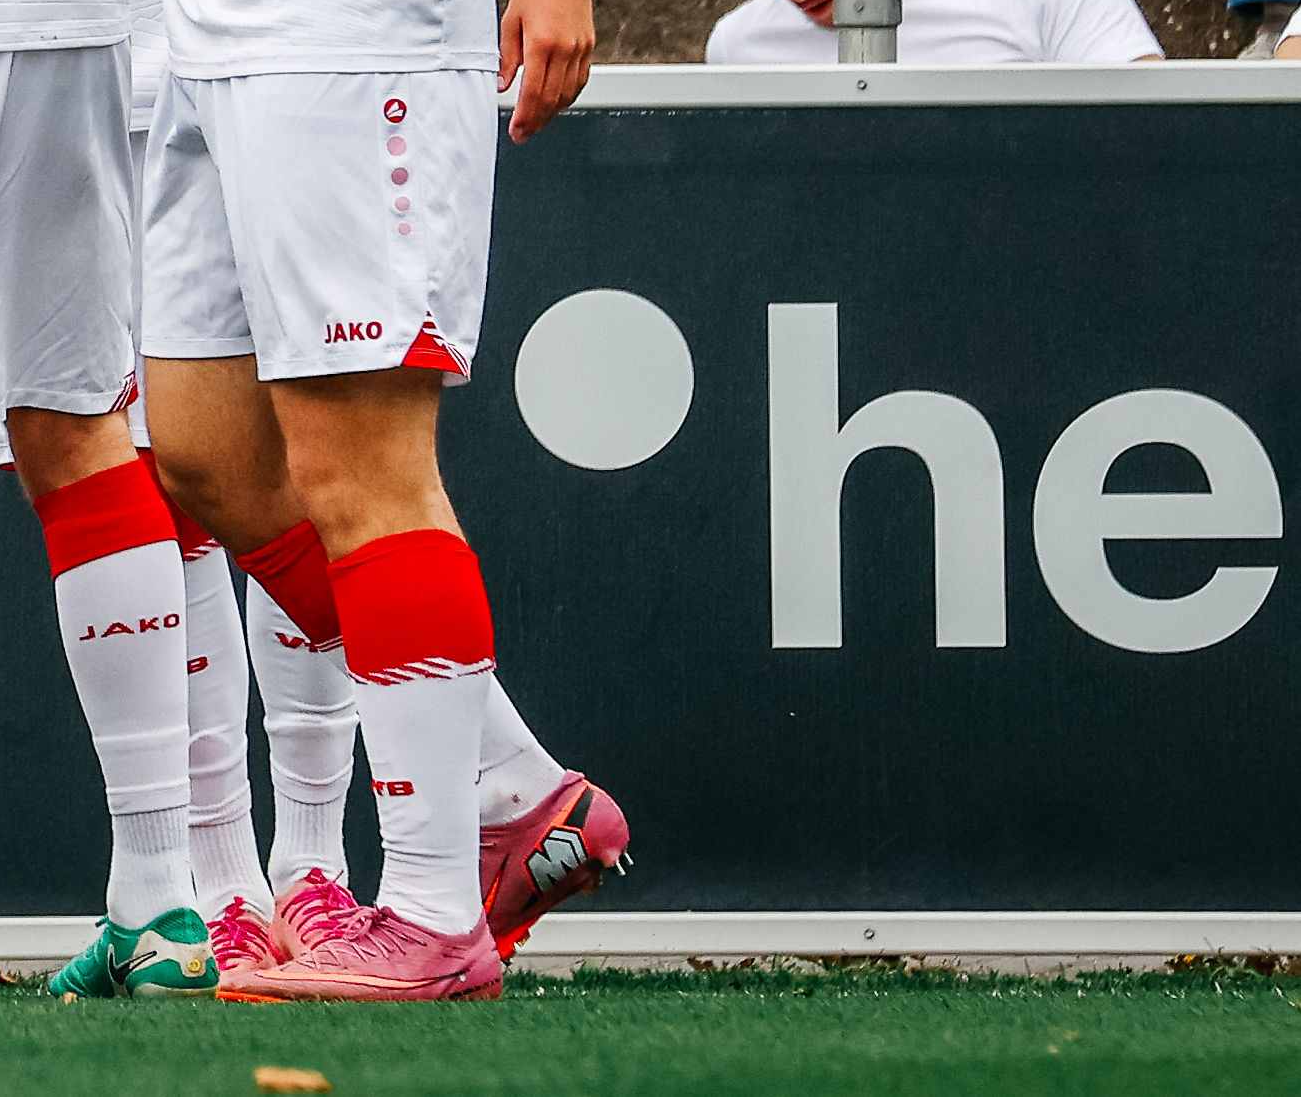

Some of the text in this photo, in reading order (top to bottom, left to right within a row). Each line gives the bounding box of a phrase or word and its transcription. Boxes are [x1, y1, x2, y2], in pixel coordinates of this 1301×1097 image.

[325, 321, 383, 344] JAKO
[768, 302, 1284, 654] he
[79, 613, 180, 641] JAKO
